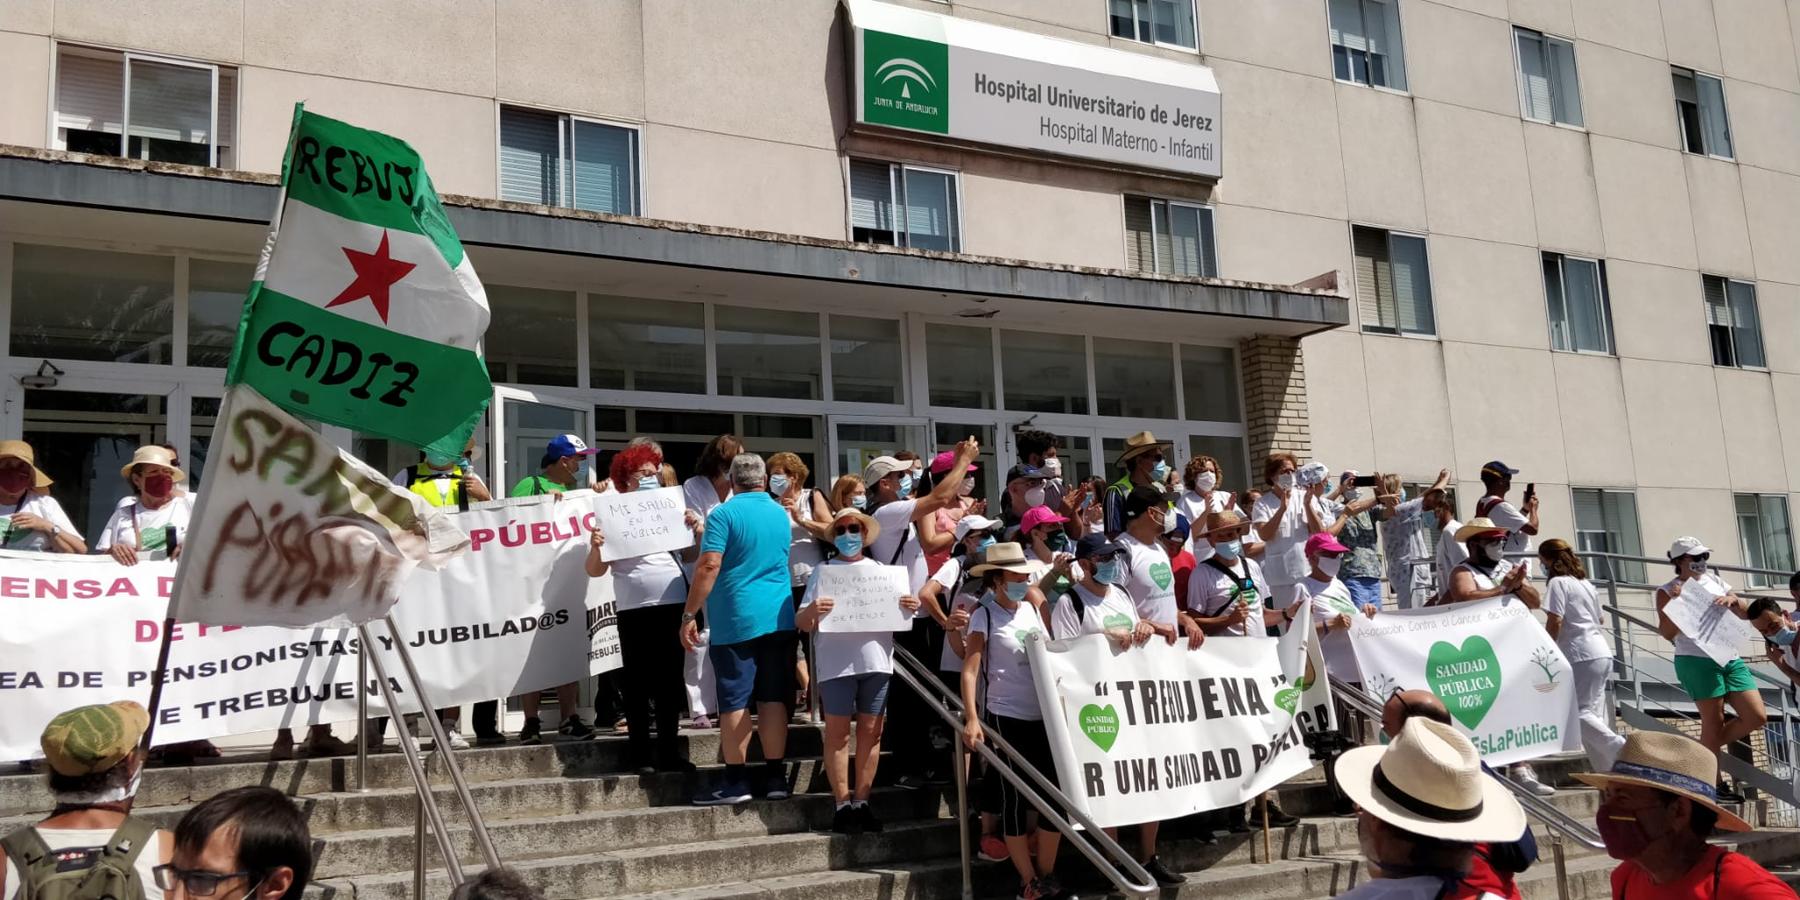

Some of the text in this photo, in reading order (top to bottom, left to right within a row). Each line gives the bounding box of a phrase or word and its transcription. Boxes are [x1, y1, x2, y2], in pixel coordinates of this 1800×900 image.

[873, 97, 893, 107] JUNTA
[895, 101, 904, 109] DE
[974, 72, 1213, 131] Hospital Universitario de Jerez
[1040, 116, 1097, 144] Hospital
[1102, 126, 1158, 153] Materno
[1169, 136, 1213, 162] Infantil
[257, 321, 420, 407] CADIZ
[638, 497, 678, 512] SALUD
[1, 576, 139, 600] ENSA
[0, 608, 570, 690] EA DE PENSIONISTAS Y JUBILAD@S
[1436, 658, 1488, 679] SANIDAD
[194, 676, 404, 720] TREBUJENA
[1116, 676, 1271, 726] TREBUJENA
[1439, 676, 1495, 697] PÚBLICA
[1458, 694, 1483, 709] 100%
[1083, 762, 1106, 798] R
[1114, 757, 1160, 795] UNA
[1165, 747, 1243, 790] SANIDAD
